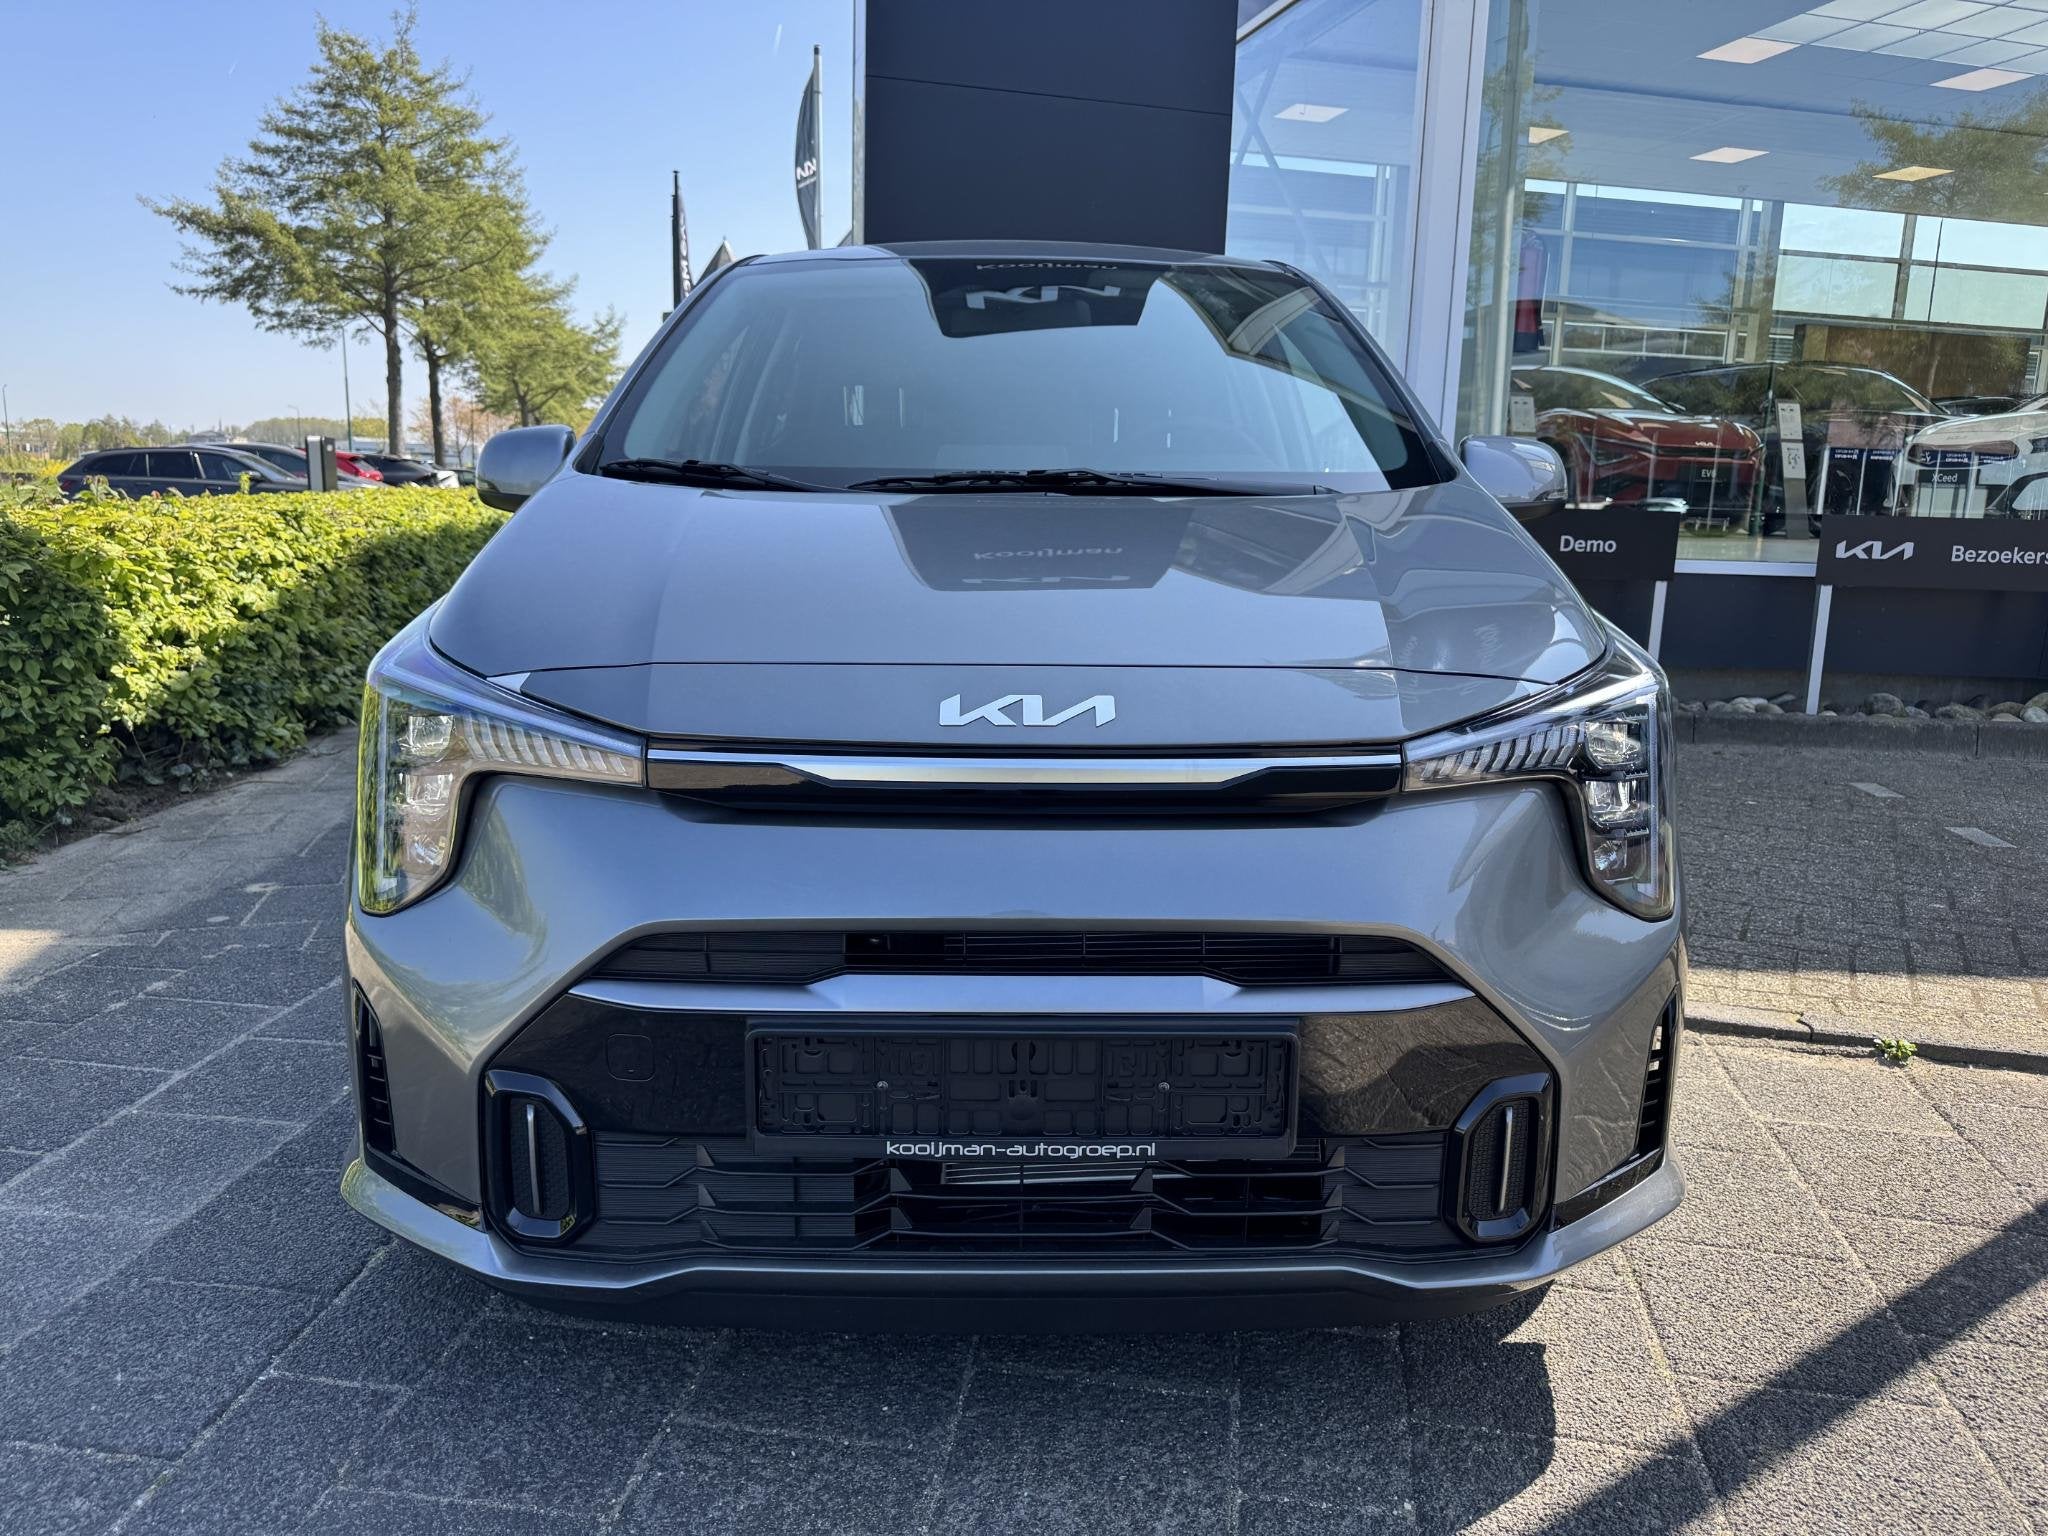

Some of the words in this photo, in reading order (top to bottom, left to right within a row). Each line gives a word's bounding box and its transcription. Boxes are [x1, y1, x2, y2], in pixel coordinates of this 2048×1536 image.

[1931, 472, 1958, 483] XCeed
[1559, 534, 1617, 554] Demo
[1835, 539, 1914, 561] KIA
[939, 693, 1116, 728] KIA
[885, 1140, 1157, 1160] kooijman-autogroep.nl
